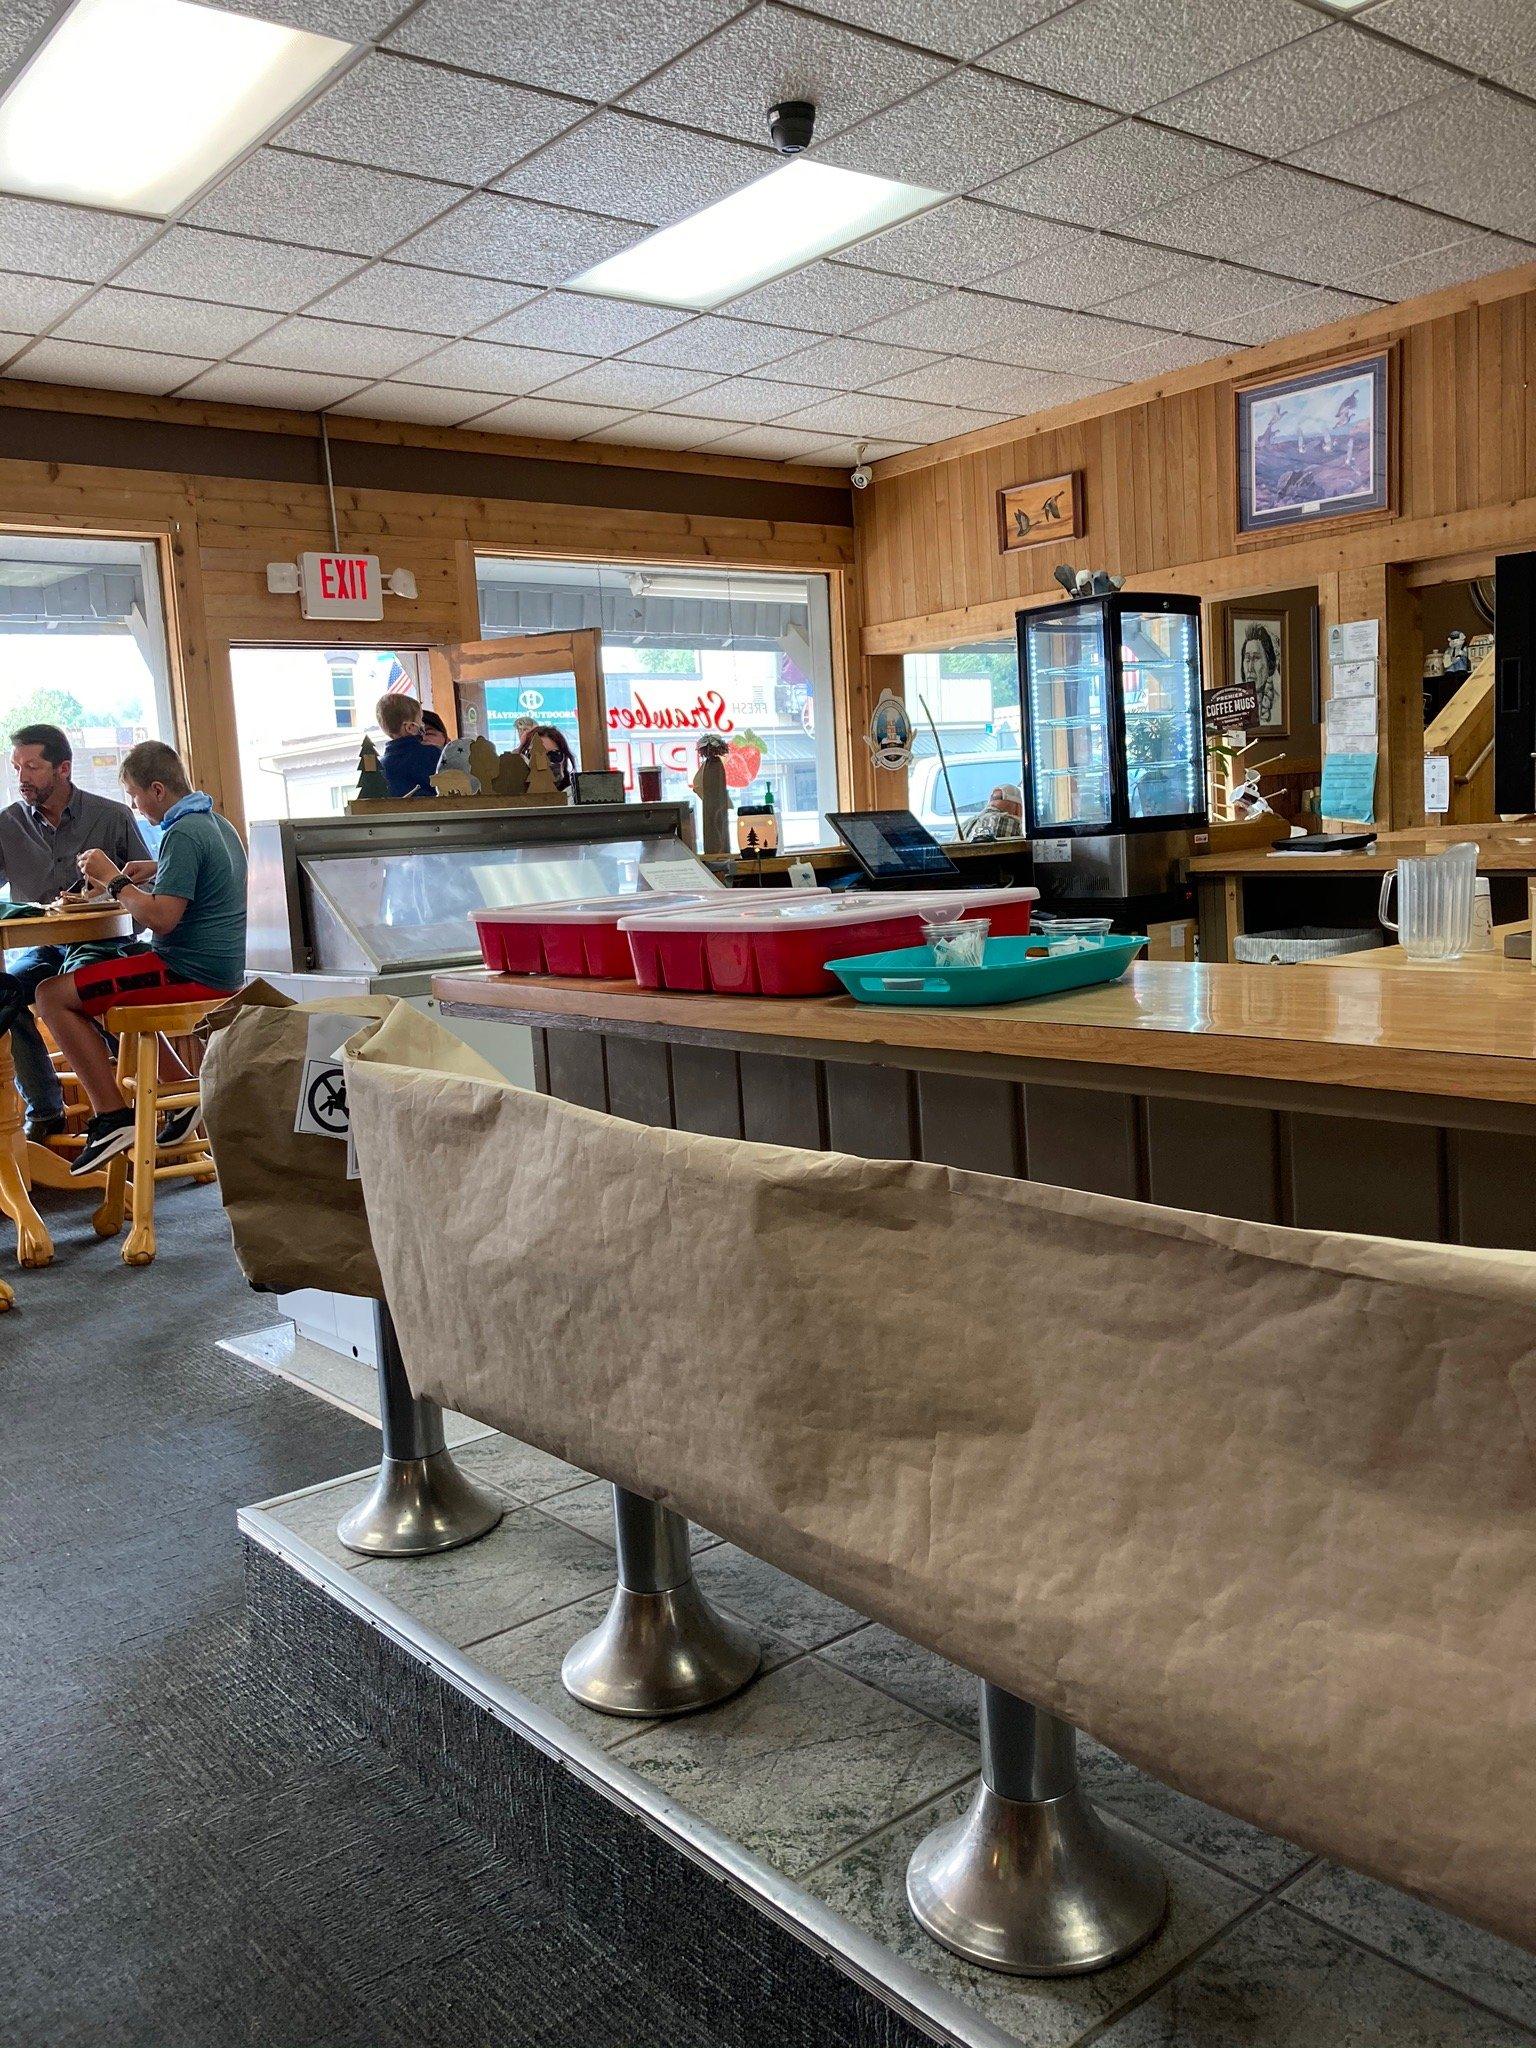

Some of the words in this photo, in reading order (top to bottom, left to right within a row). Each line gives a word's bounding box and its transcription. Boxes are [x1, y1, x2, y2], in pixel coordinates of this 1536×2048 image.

[320, 558, 368, 600] EXIT
[1206, 700, 1234, 717] COFFEE
[1234, 696, 1256, 712] MUGS
[1216, 692, 1243, 702] PREMIER
